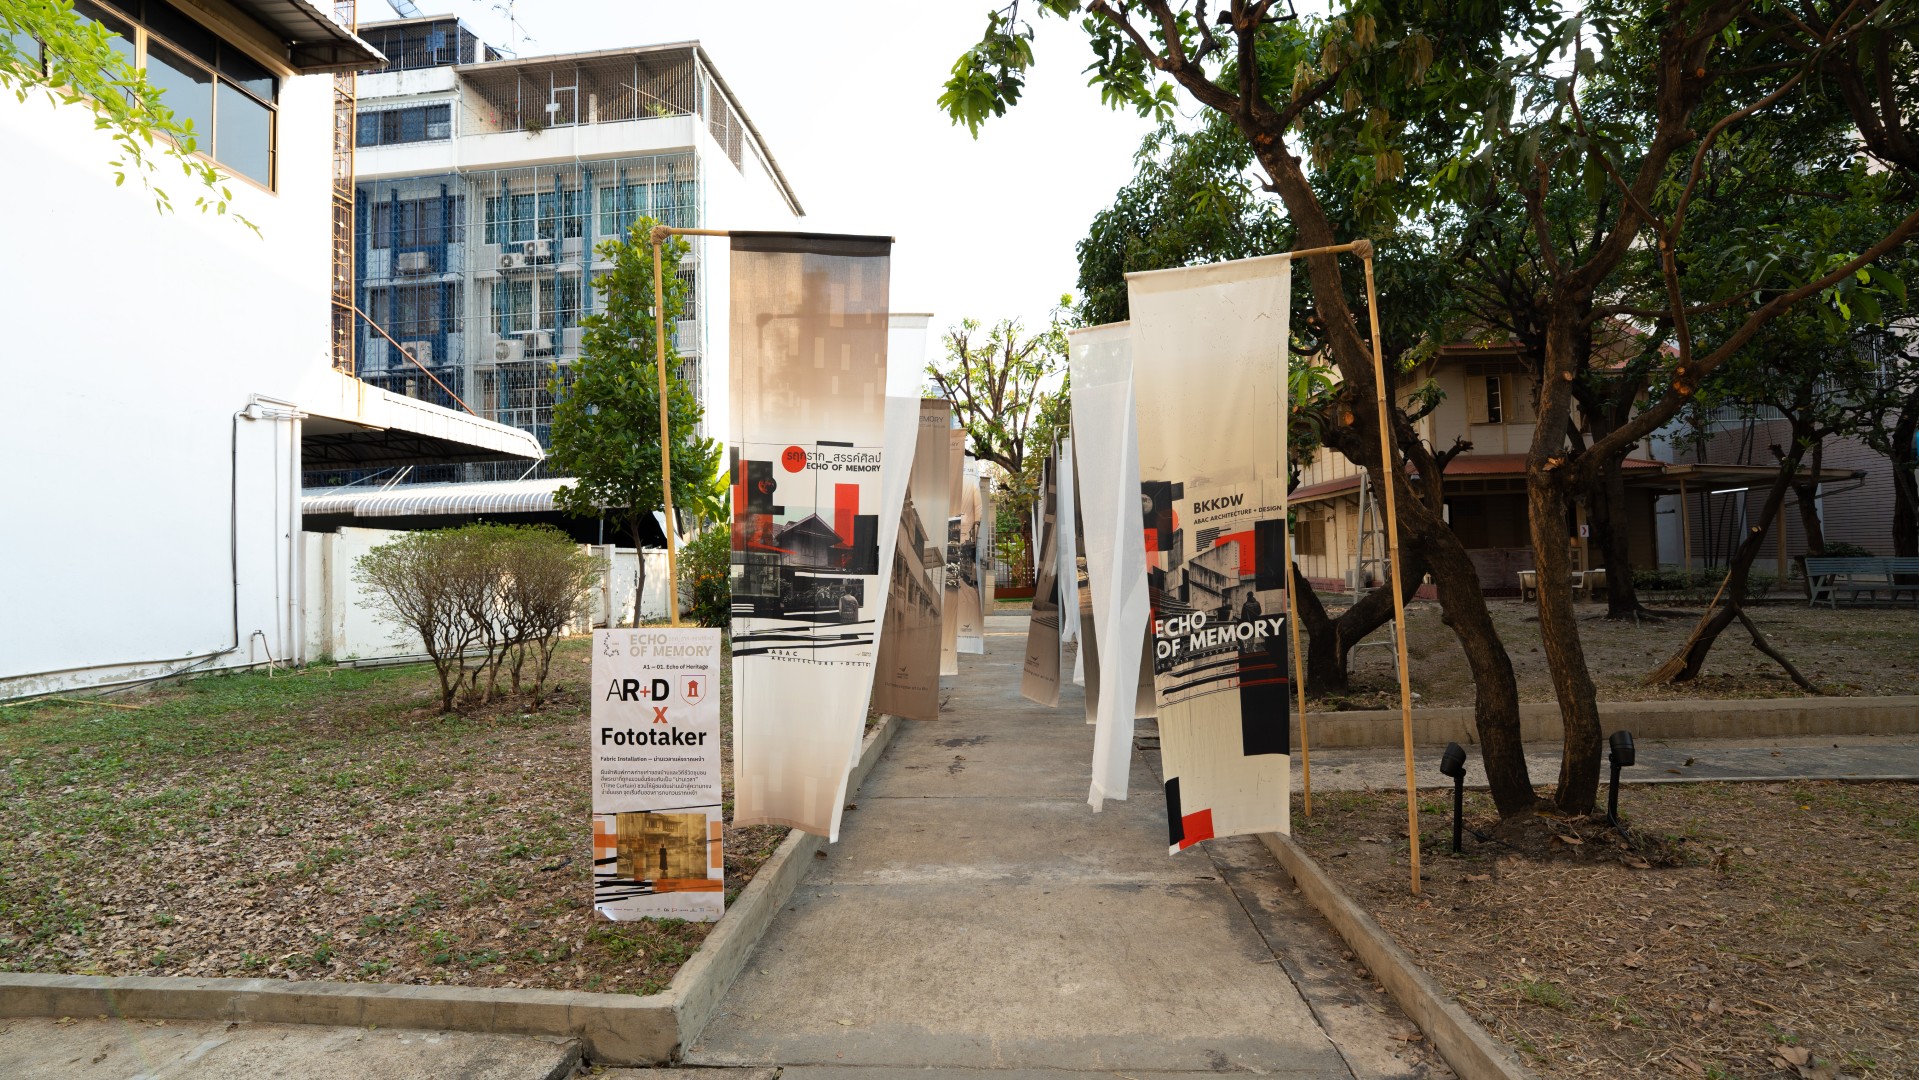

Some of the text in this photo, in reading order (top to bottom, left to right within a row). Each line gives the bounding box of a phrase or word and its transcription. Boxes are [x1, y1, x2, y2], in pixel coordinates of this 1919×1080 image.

[919, 415, 944, 423] EMORY
[806, 462, 828, 470] ECHO
[845, 464, 880, 472] MEMORY
[1193, 493, 1244, 514] BKKDW
[1193, 516, 1209, 525] ABAC
[1210, 508, 1252, 521] ARCHITECTURE
[1258, 505, 1282, 513] DESIGN
[1155, 610, 1207, 639] ECHO
[630, 634, 667, 645] ECHO
[1157, 617, 1285, 659] OF MEMORY
[630, 646, 712, 657] OF MEMORY
[771, 649, 798, 657] ABAC
[606, 678, 670, 702] AR+D
[601, 726, 707, 746] Fototaker
